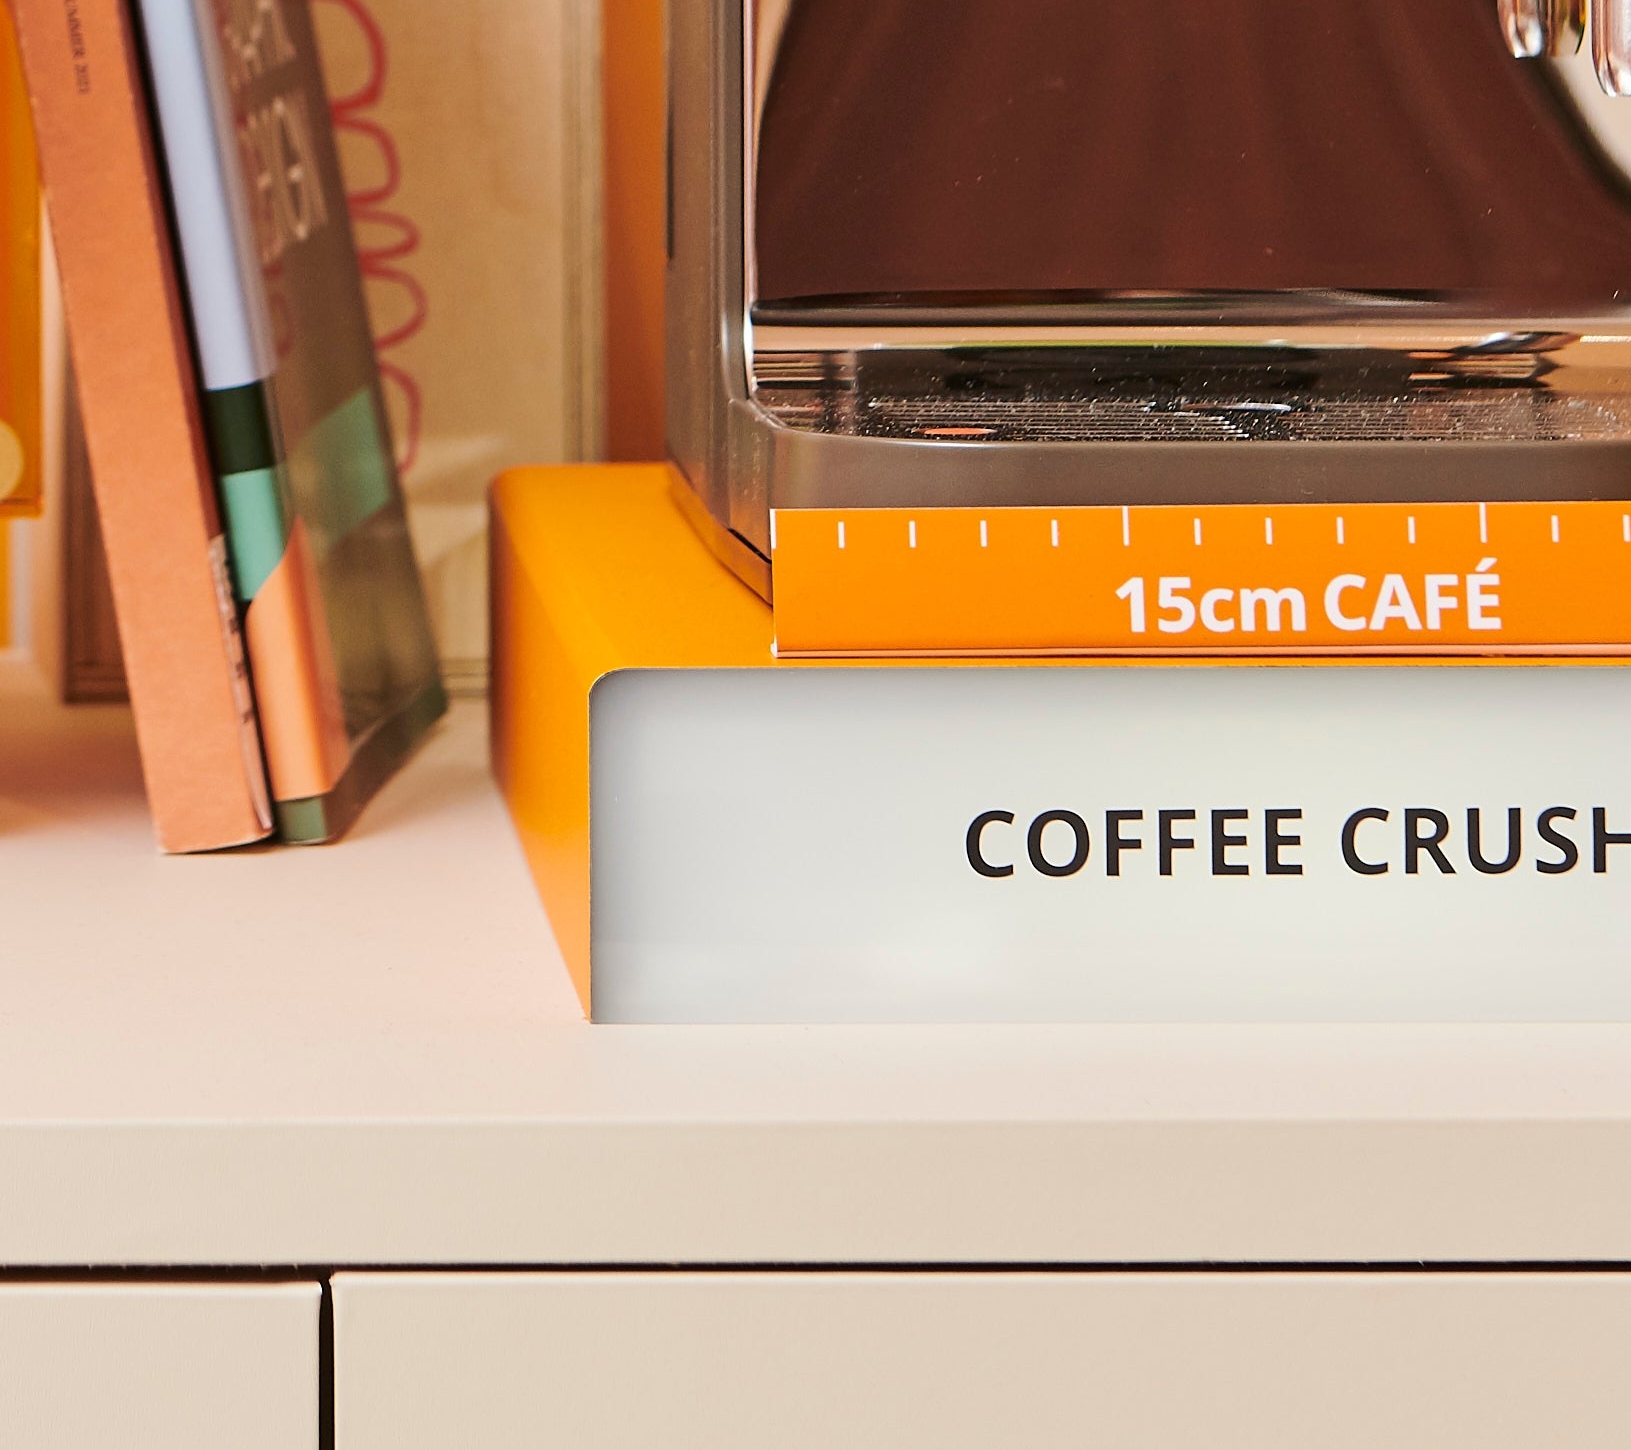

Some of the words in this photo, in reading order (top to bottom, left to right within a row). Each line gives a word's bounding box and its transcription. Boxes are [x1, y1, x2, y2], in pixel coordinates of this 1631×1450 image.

[1115, 576, 1307, 632] 15cm
[1324, 557, 1503, 631] CAFÉ
[965, 808, 1304, 877] COFFEE
